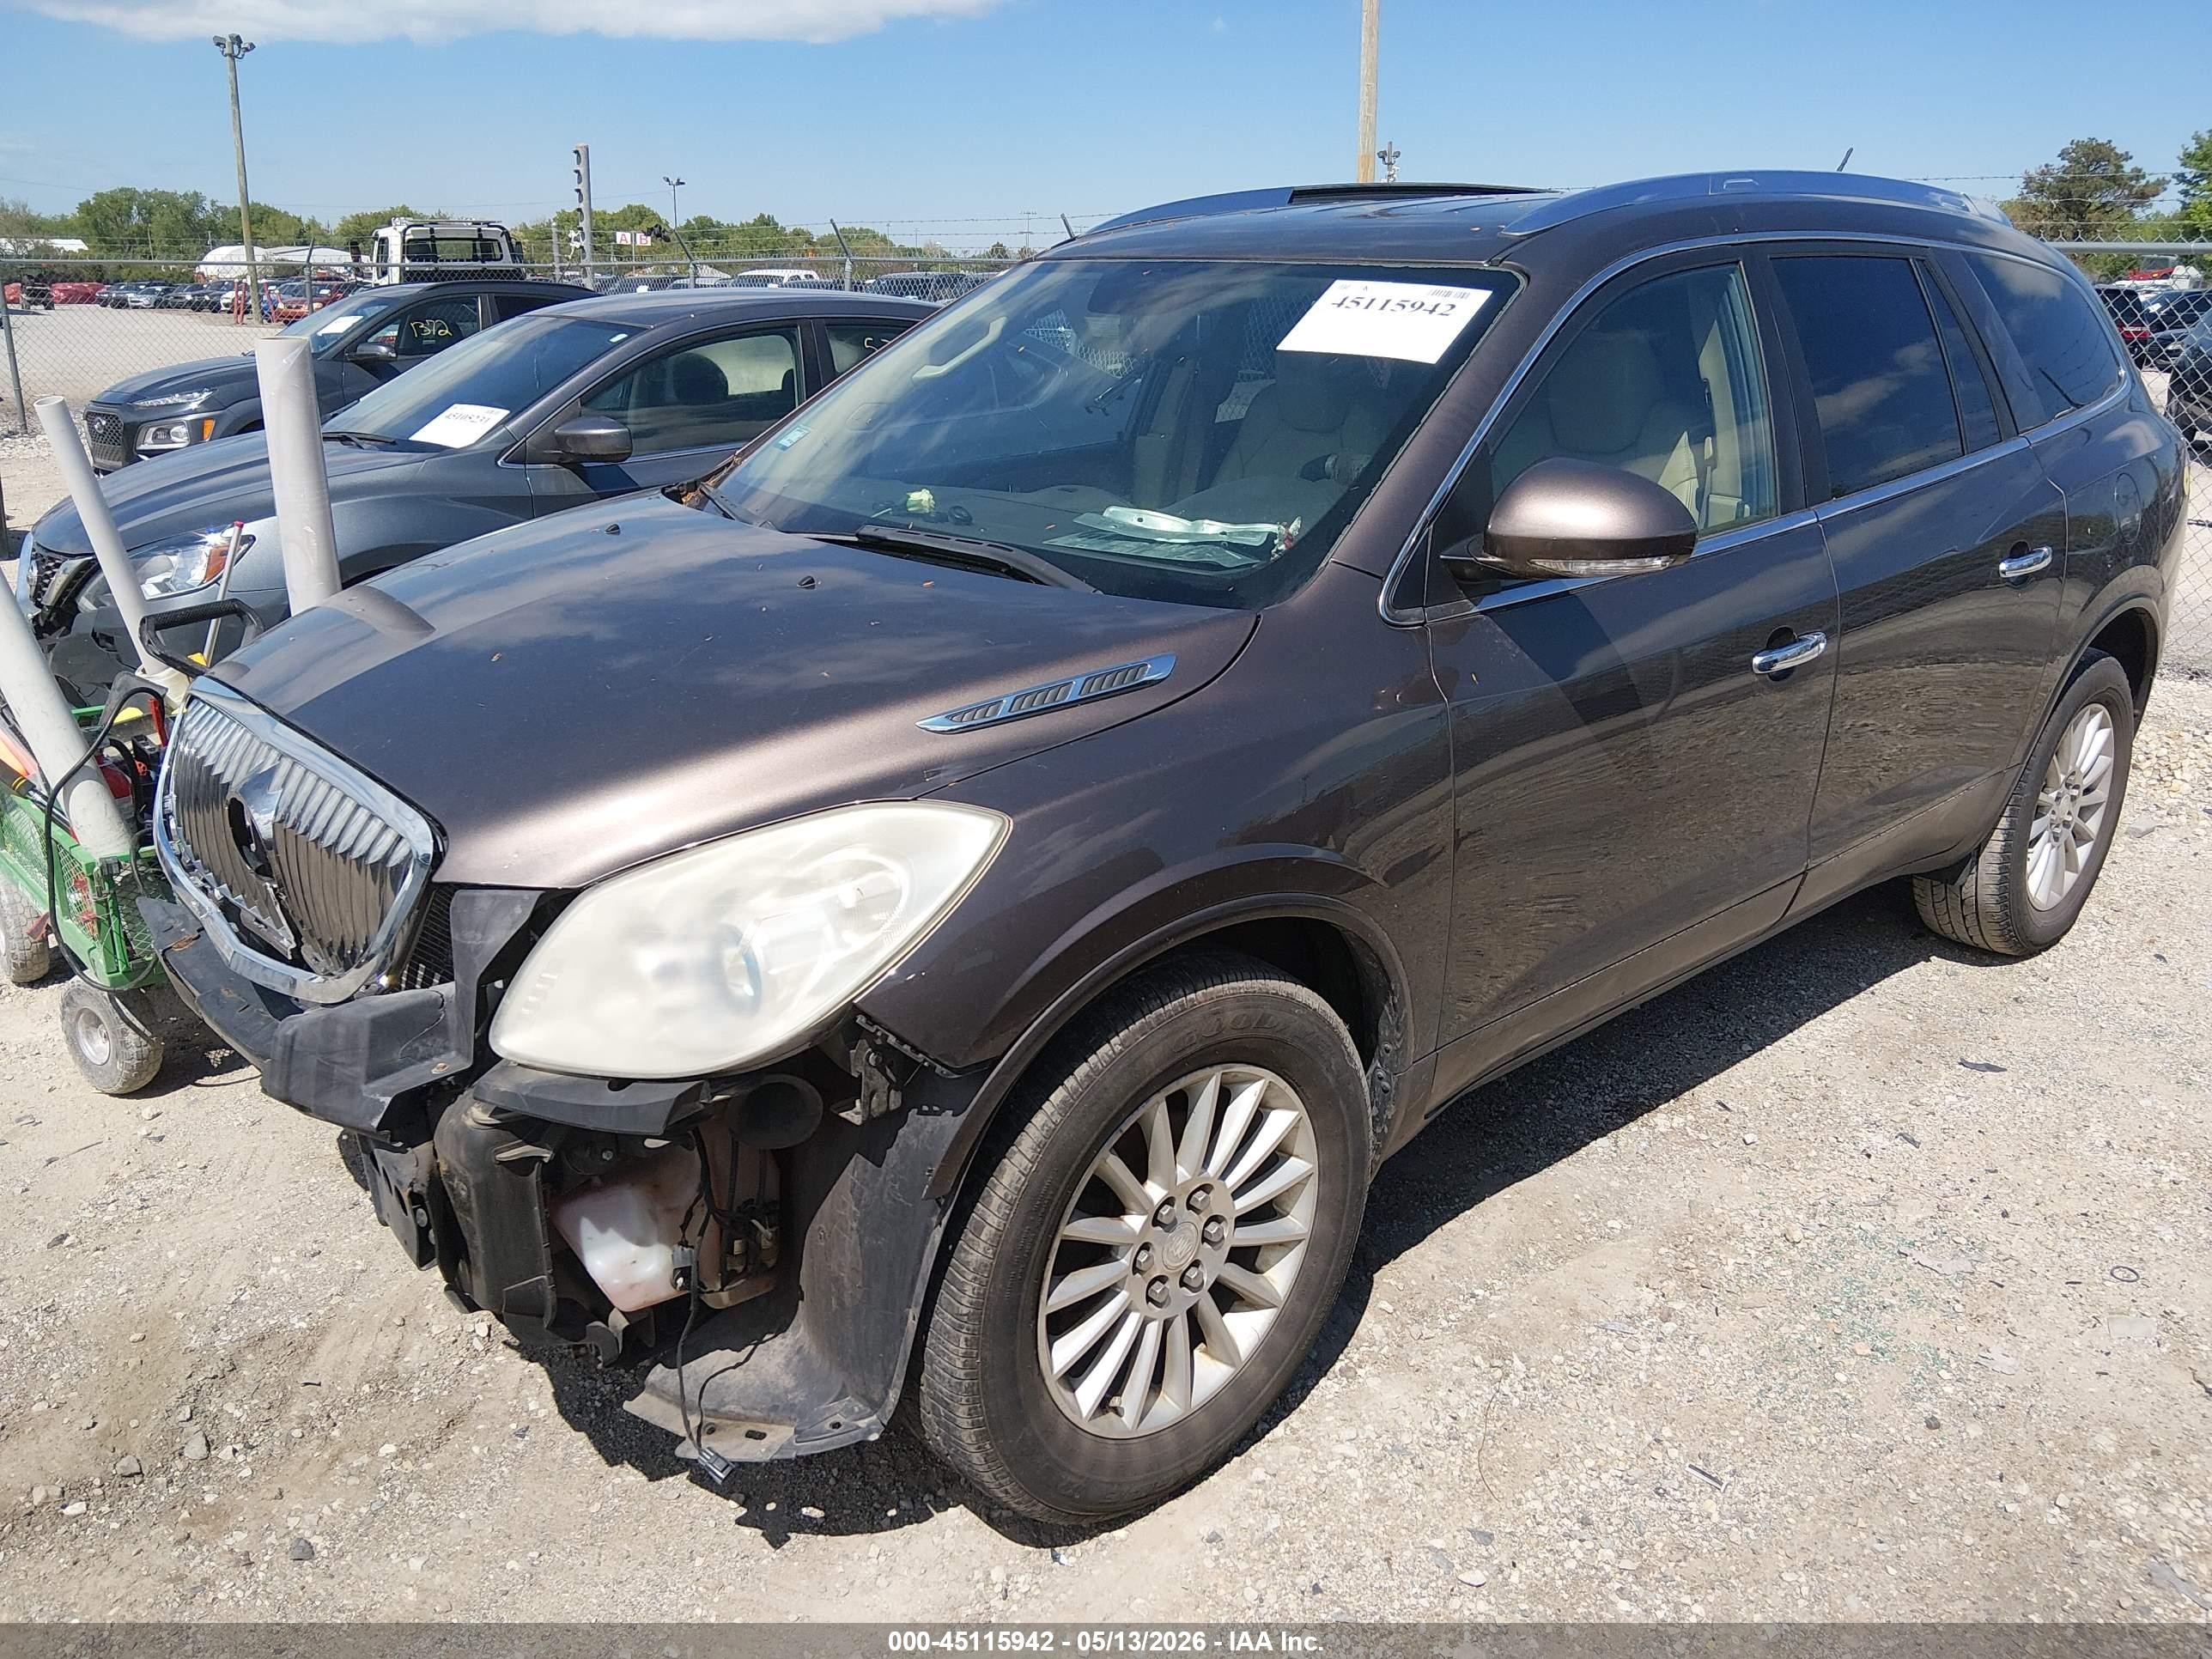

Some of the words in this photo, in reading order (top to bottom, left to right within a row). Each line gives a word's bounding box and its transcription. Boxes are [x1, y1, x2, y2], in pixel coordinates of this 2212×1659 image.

[619, 233, 629, 244] A
[639, 234, 648, 245] B
[1331, 295, 1457, 317] 45115942
